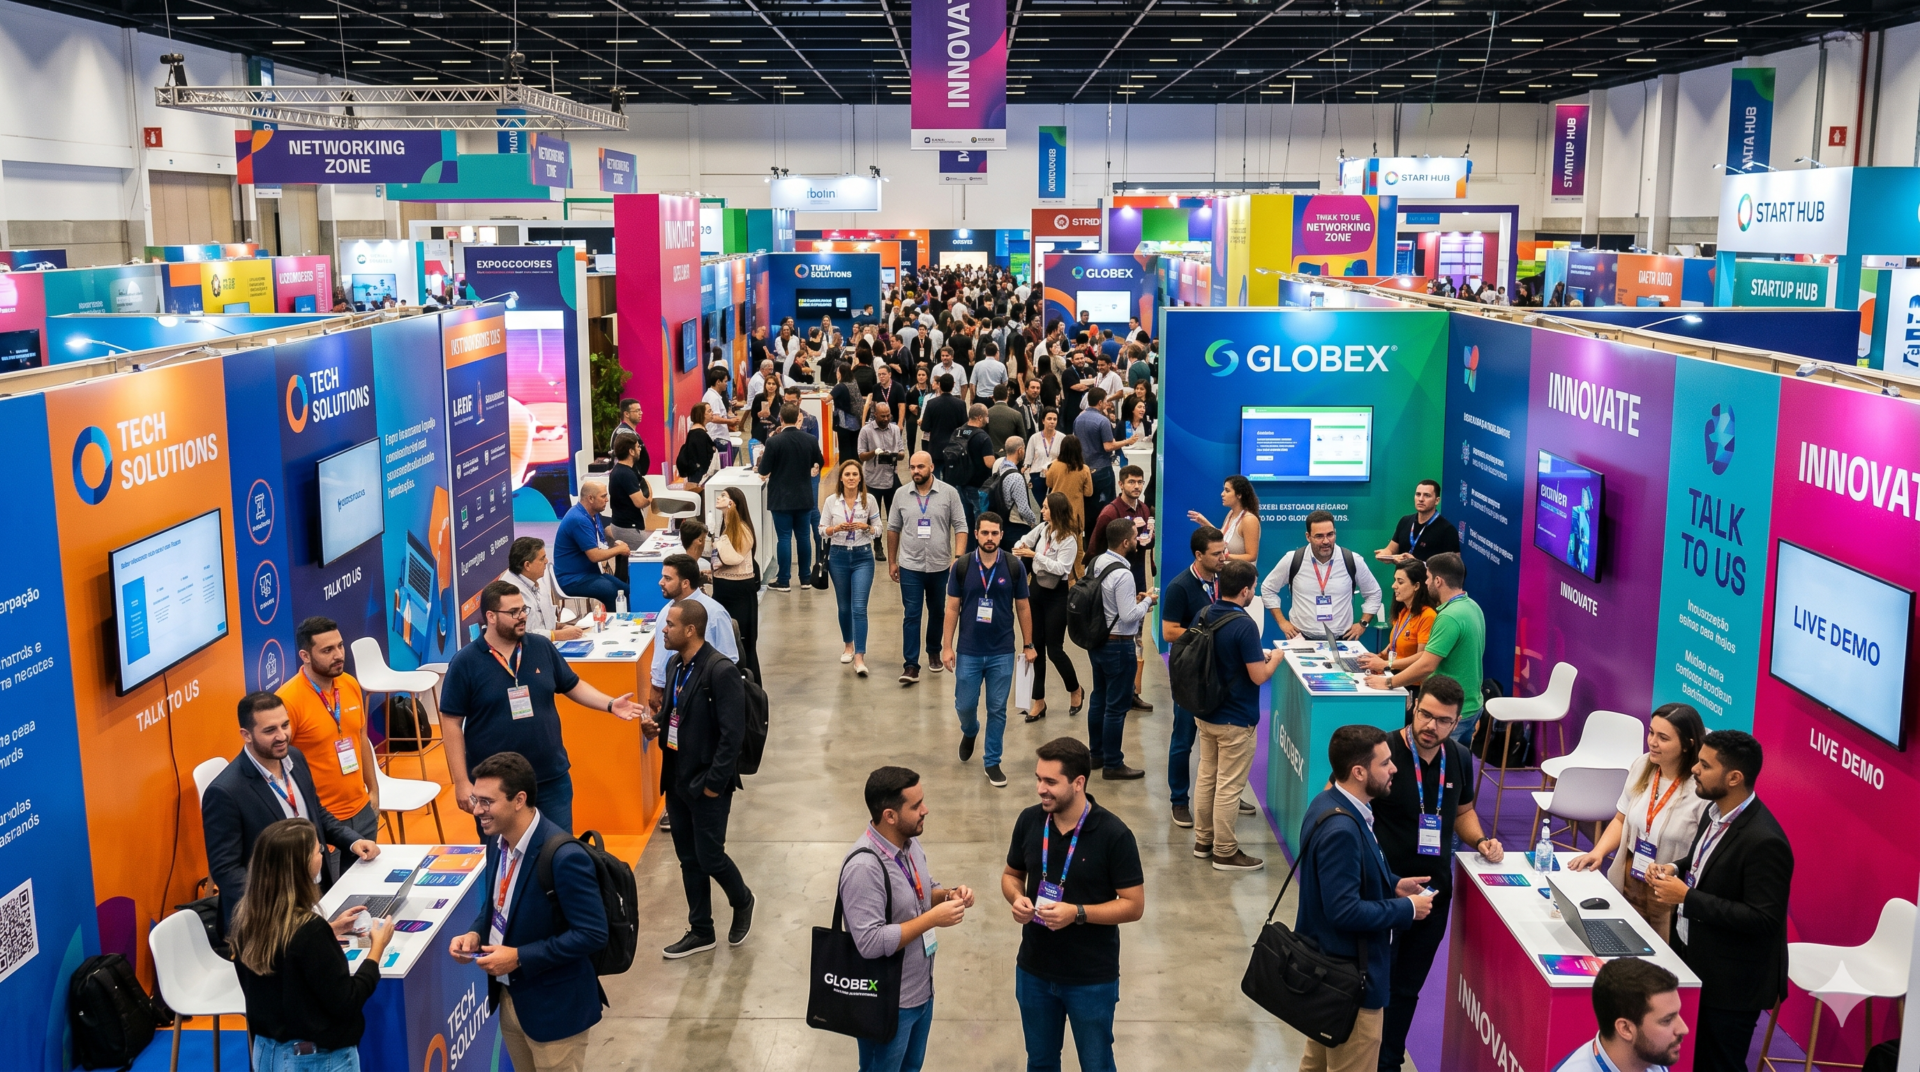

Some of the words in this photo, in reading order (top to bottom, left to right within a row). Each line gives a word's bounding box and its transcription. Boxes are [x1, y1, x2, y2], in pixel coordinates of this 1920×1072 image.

[947, 0, 971, 108] INNOVA
[1566, 117, 1576, 140] HUB
[288, 140, 405, 155] NETWORKING
[325, 159, 371, 174] ZONE
[1431, 174, 1450, 182] HUB
[1306, 222, 1371, 232] NETWORKING
[1756, 202, 1795, 223] START
[1796, 201, 1825, 222] HUB
[1325, 233, 1352, 242] ZONE
[1086, 268, 1134, 279] GLOBEX
[1751, 278, 1794, 298] STARTUP
[1795, 282, 1818, 301] HUB
[310, 366, 340, 395] TECH
[312, 385, 370, 423] SOLUTIONS
[1548, 371, 1642, 438] INNOVATE
[116, 411, 167, 452] TECH
[120, 433, 218, 490] SOLUTIONS
[1688, 487, 1746, 547] TALK
[1681, 531, 1709, 578] TO
[1714, 547, 1747, 597] US
[323, 578, 342, 601] TALK
[341, 572, 353, 589] TO
[352, 566, 362, 583] US
[1560, 581, 1598, 617] INNOVATE
[1793, 604, 1827, 641] LIVE
[1830, 622, 1881, 667] DEMO
[136, 699, 166, 732] TALK
[166, 690, 183, 713] TO
[184, 679, 200, 703] US
[1279, 724, 1305, 782] GLOBEX
[1810, 727, 1839, 763] LIVE
[1841, 746, 1885, 790] DEMO
[824, 972, 879, 992] GLOBEX
[447, 981, 476, 1040] TECH
